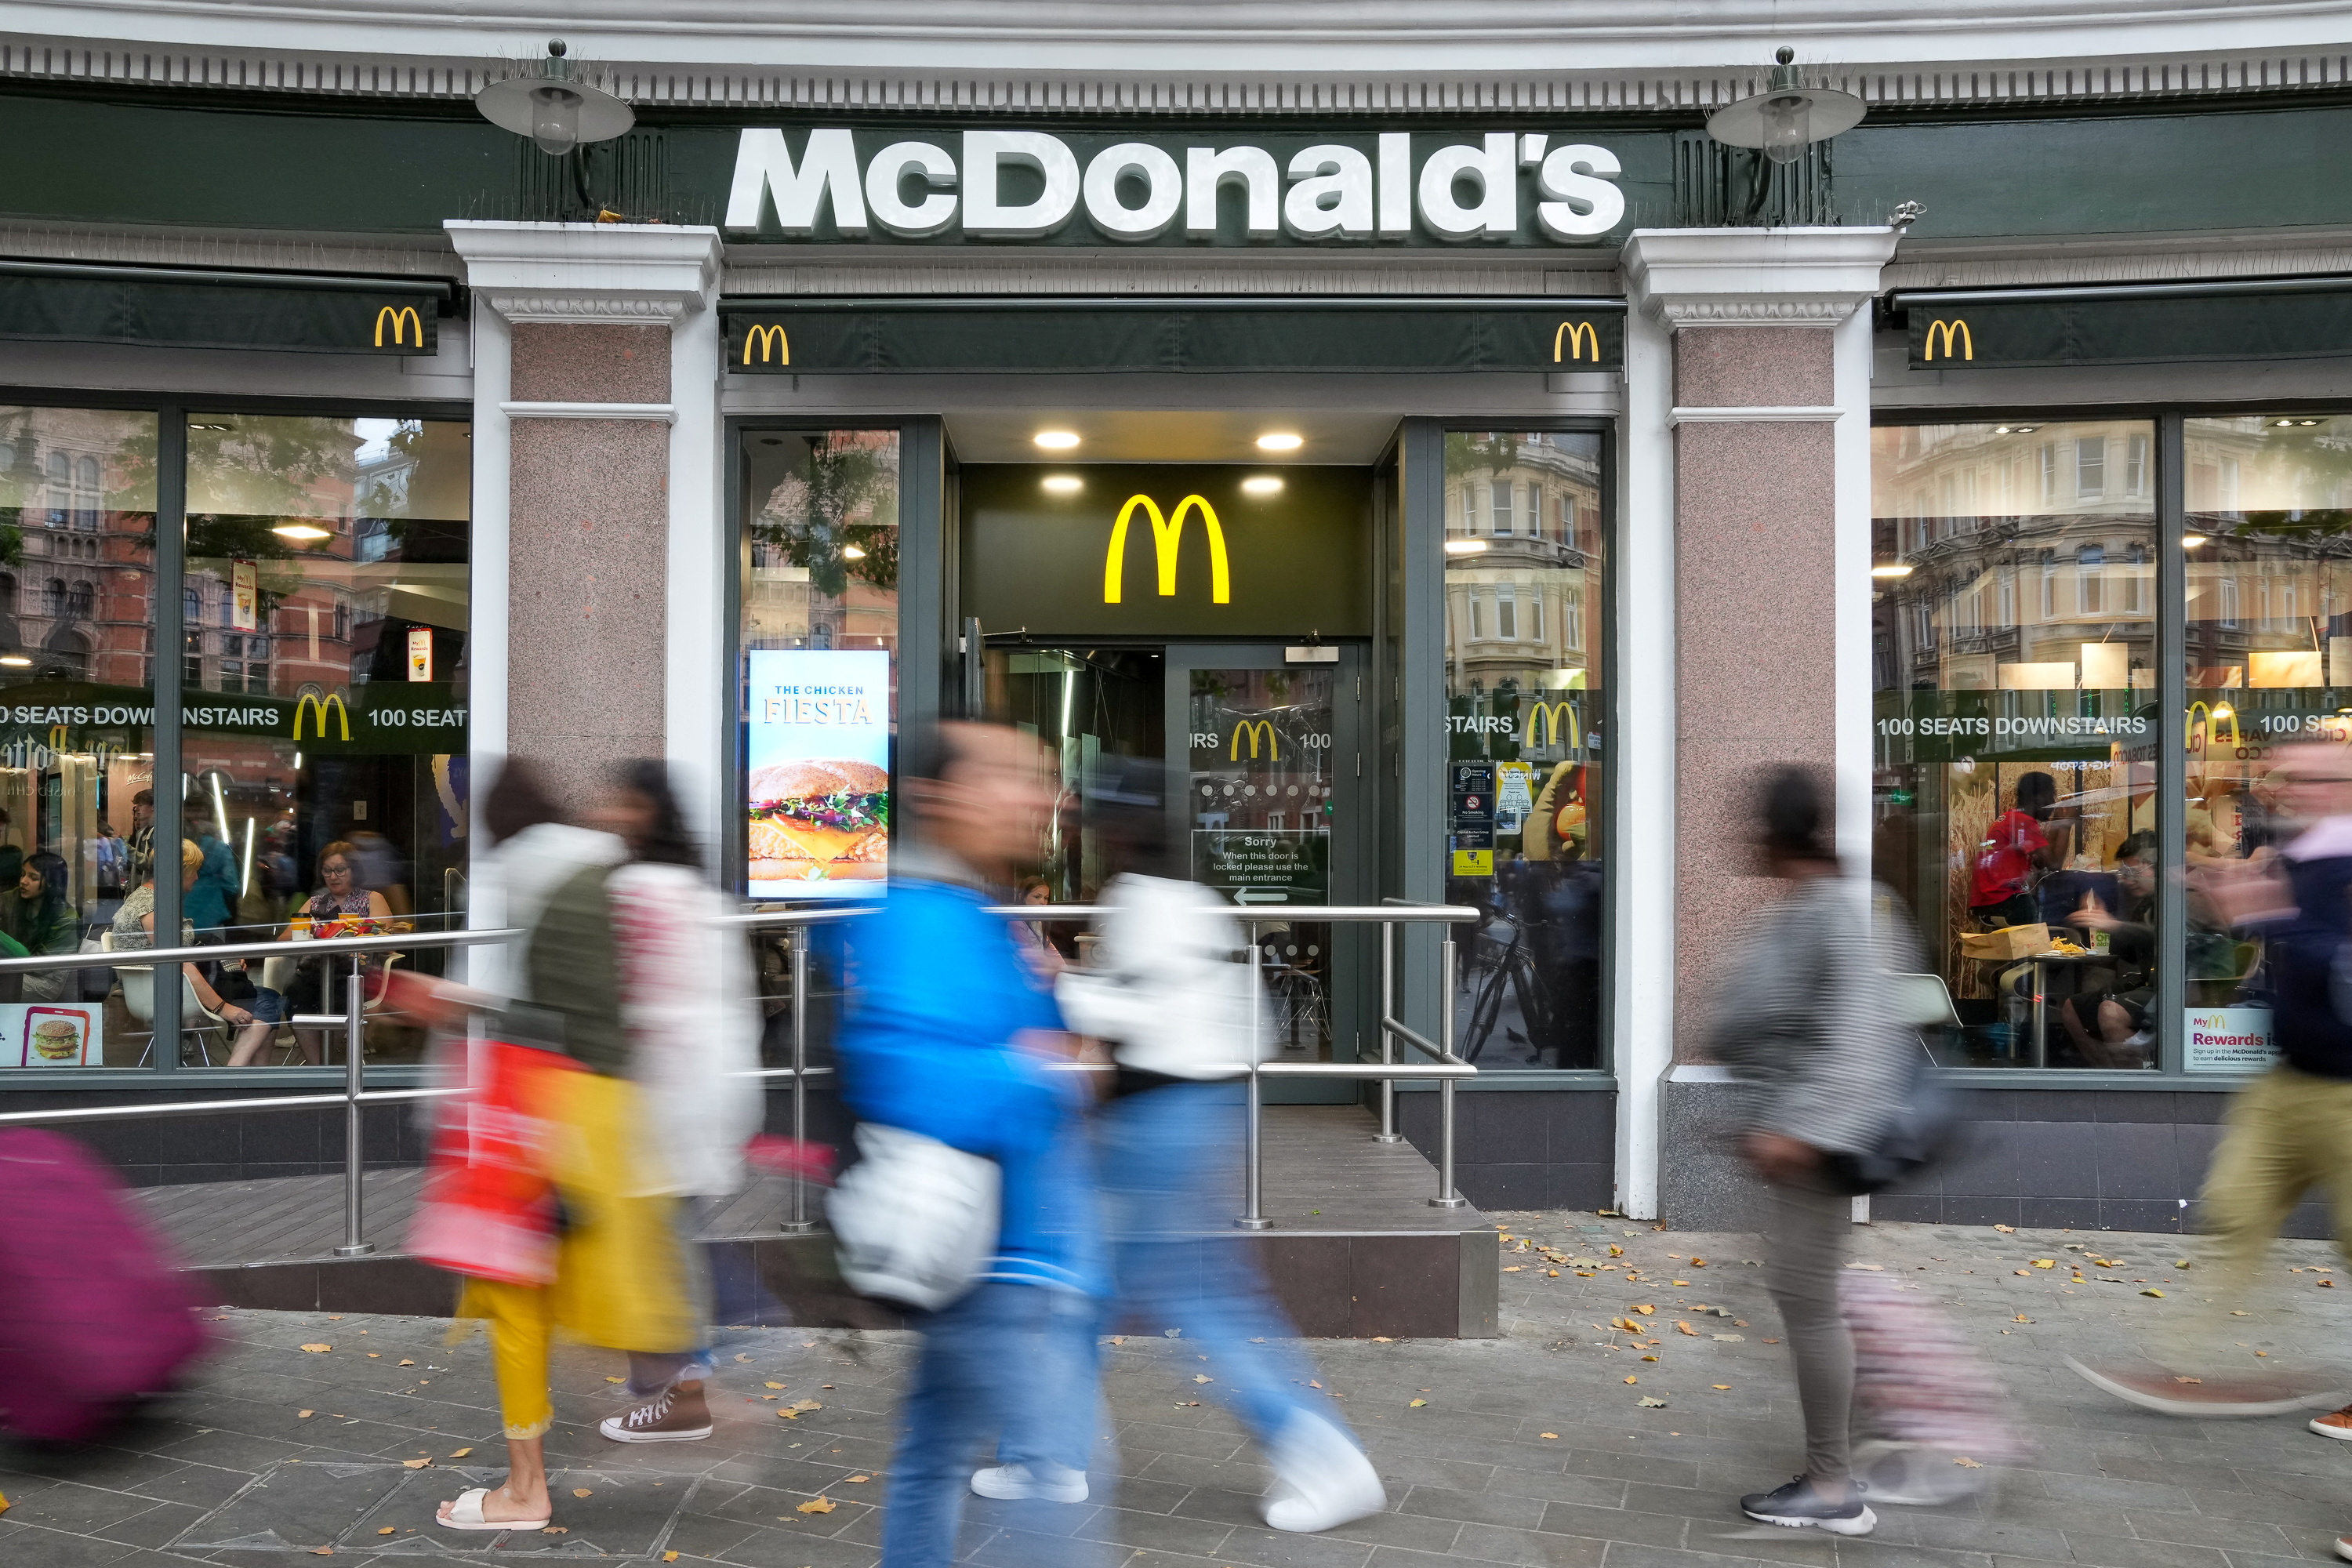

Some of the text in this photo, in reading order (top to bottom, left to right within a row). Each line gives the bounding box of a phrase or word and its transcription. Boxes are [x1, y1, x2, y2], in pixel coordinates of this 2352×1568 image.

[724, 128, 1626, 241] McDonald's
[775, 685, 863, 695] THE CHICKEN
[14, 706, 89, 724] SEATS
[183, 707, 279, 726] NSTAIRS
[368, 709, 406, 727] 100
[411, 710, 468, 727] SEAT
[764, 698, 873, 724] FIESTA
[1876, 717, 2147, 735] 100 SEATS DOWNSTAIRS
[2259, 715, 2299, 733] 100
[1299, 732, 1332, 749] 100
[1244, 837, 1277, 848] Sorry
[1222, 851, 1299, 860] When this door is
[1213, 862, 1243, 871] locked
[1244, 862, 1274, 873] please
[1294, 862, 1308, 871] the
[1229, 873, 1251, 882] main
[2193, 1033, 2264, 1046] Rewards
